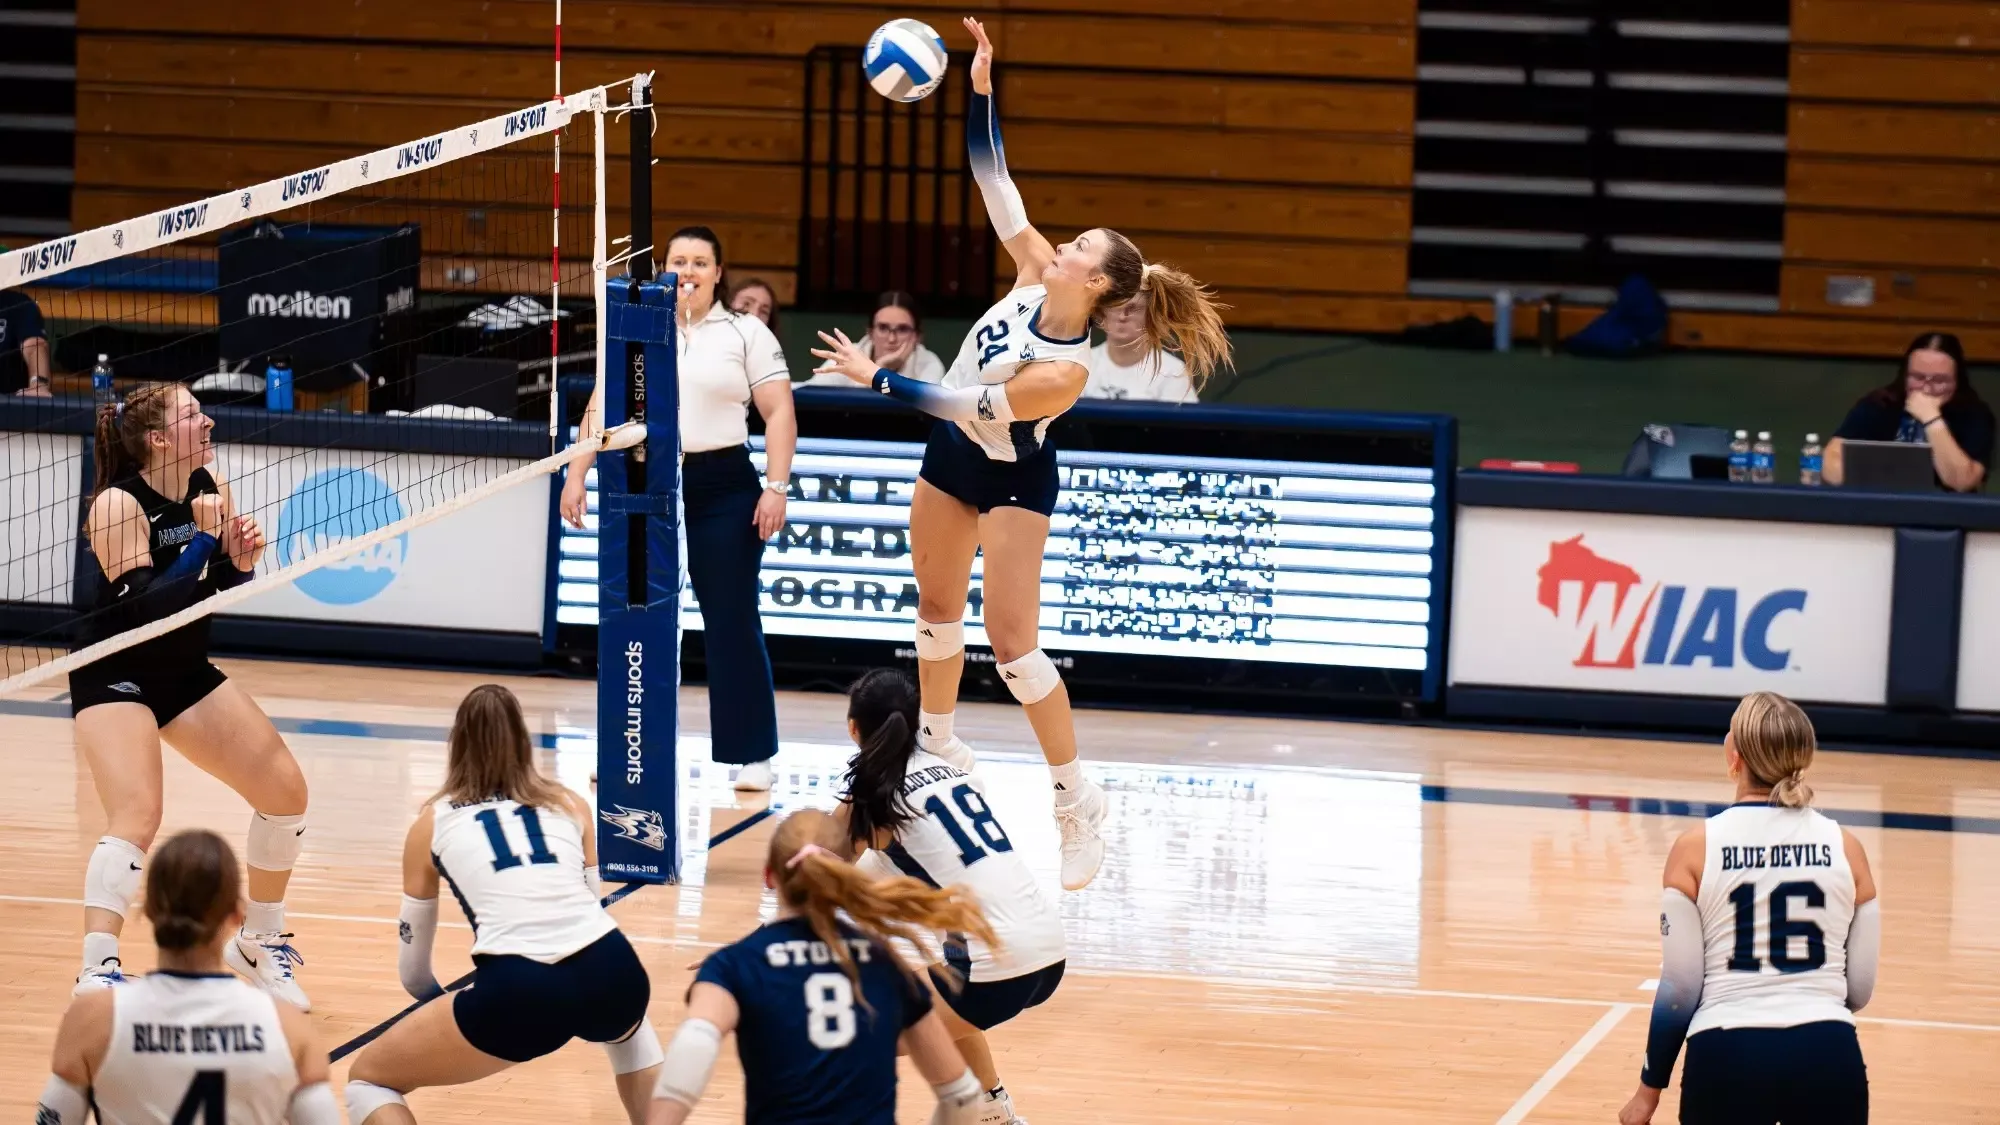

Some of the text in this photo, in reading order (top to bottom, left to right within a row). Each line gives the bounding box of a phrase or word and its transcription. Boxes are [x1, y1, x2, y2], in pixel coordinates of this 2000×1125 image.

[504, 106, 547, 137] UW-STOUT
[397, 138, 443, 170] UW-STOUT
[282, 169, 330, 202] UW-STOUT
[20, 239, 77, 277] UW-STOUT
[247, 290, 351, 320] molten
[976, 319, 1010, 373] 24
[633, 353, 645, 401] sports
[1554, 579, 1808, 671] WIAC
[624, 641, 644, 785] sports imports
[474, 804, 560, 873] 11
[924, 783, 1014, 868] 18
[606, 862, 659, 873] (800) 556-3198
[1721, 844, 1832, 870] BLUE DEVILS
[1727, 880, 1827, 975] 16
[803, 972, 857, 1050] 8
[132, 1023, 264, 1053] BLUE DEVILS
